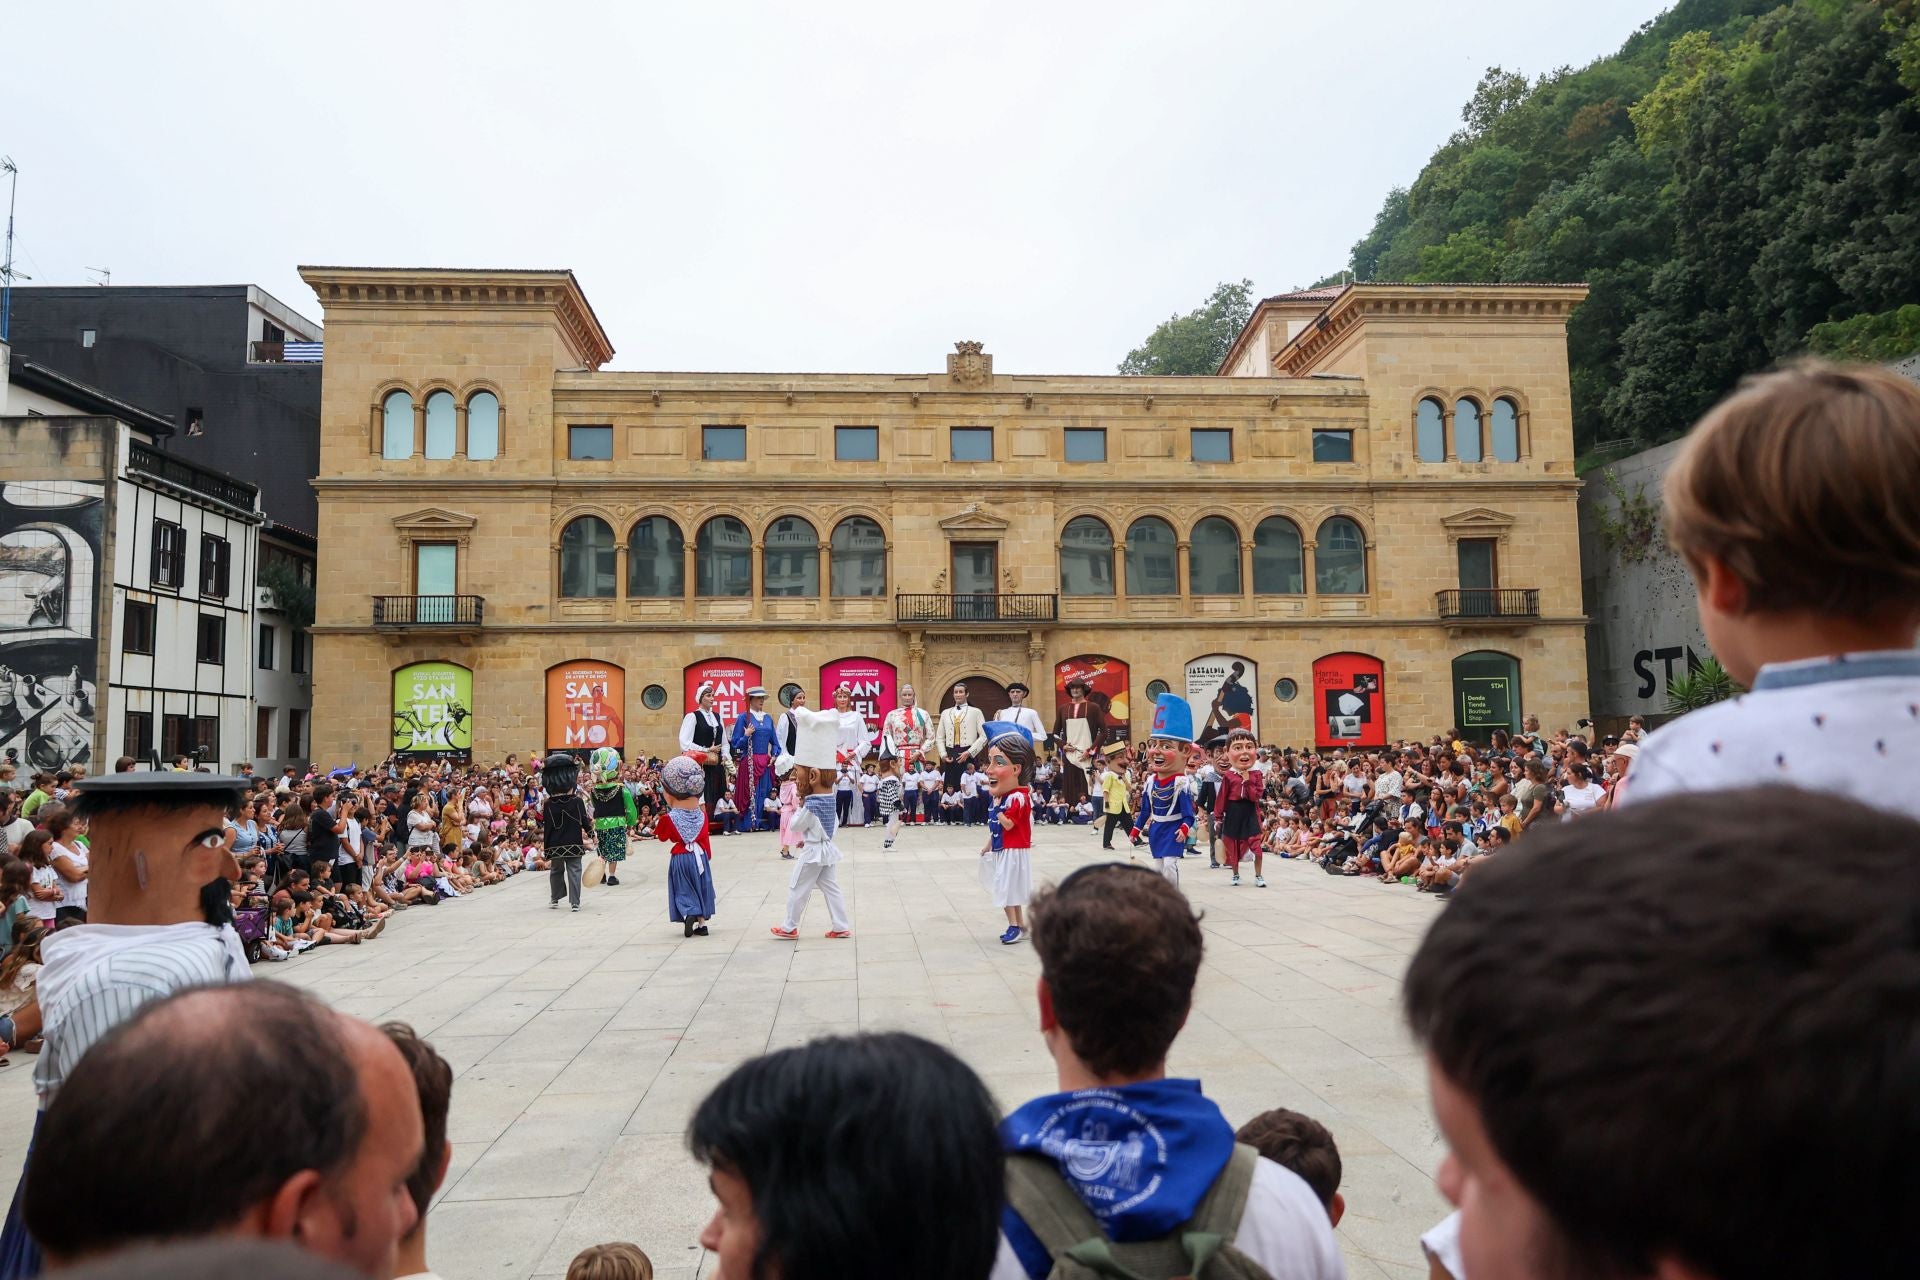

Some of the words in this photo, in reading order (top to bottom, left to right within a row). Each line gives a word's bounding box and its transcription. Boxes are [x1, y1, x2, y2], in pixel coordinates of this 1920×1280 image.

[930, 634, 962, 643] MUSEO
[970, 634, 1019, 643] MUNICIPAL
[1064, 670, 1085, 680] musika
[412, 683, 456, 700] SAN
[565, 682, 608, 699] SAN
[412, 704, 455, 723] TEL
[565, 702, 608, 721] TEL
[412, 727, 455, 746] MO
[565, 725, 607, 745] MO
